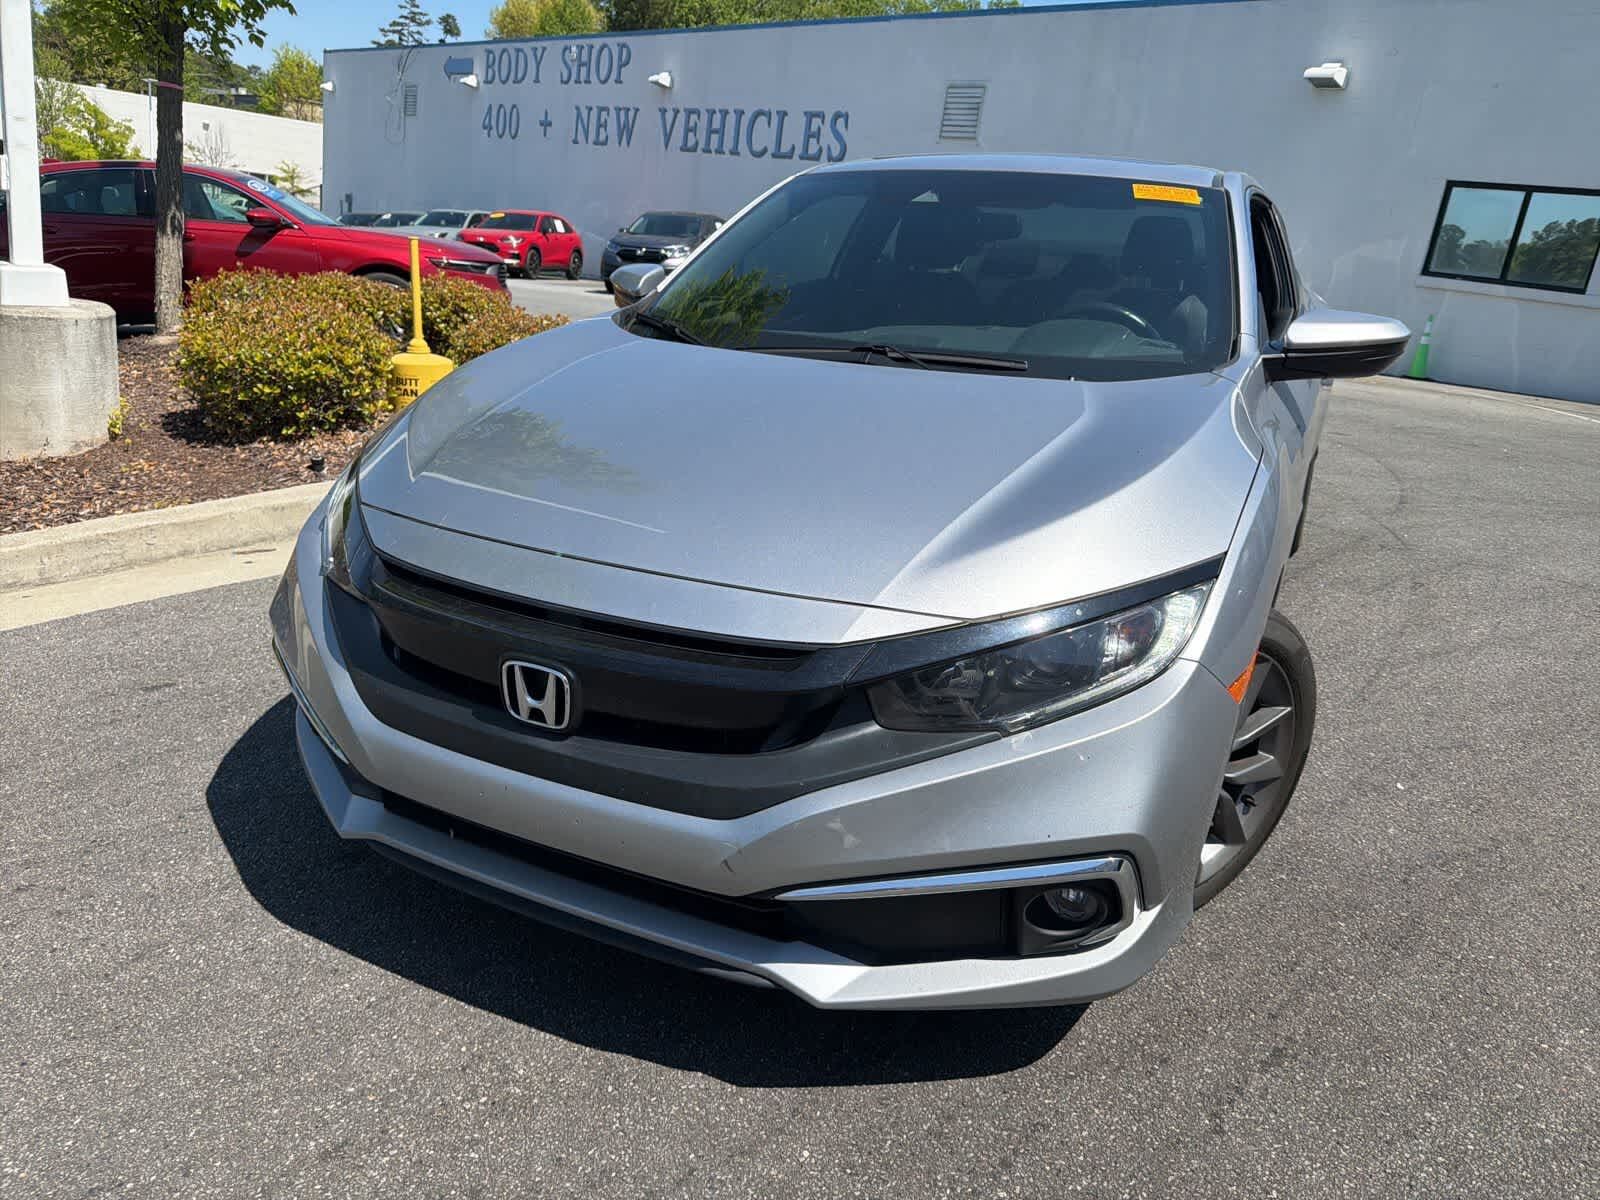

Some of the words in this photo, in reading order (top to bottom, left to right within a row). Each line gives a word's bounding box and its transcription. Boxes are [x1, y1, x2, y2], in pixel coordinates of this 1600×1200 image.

[484, 46, 547, 85] BODY
[560, 42, 632, 85] SHOP
[481, 103, 520, 140] 400
[539, 108, 553, 138] +
[572, 105, 640, 148] NEW
[657, 107, 850, 162] VEHICLES
